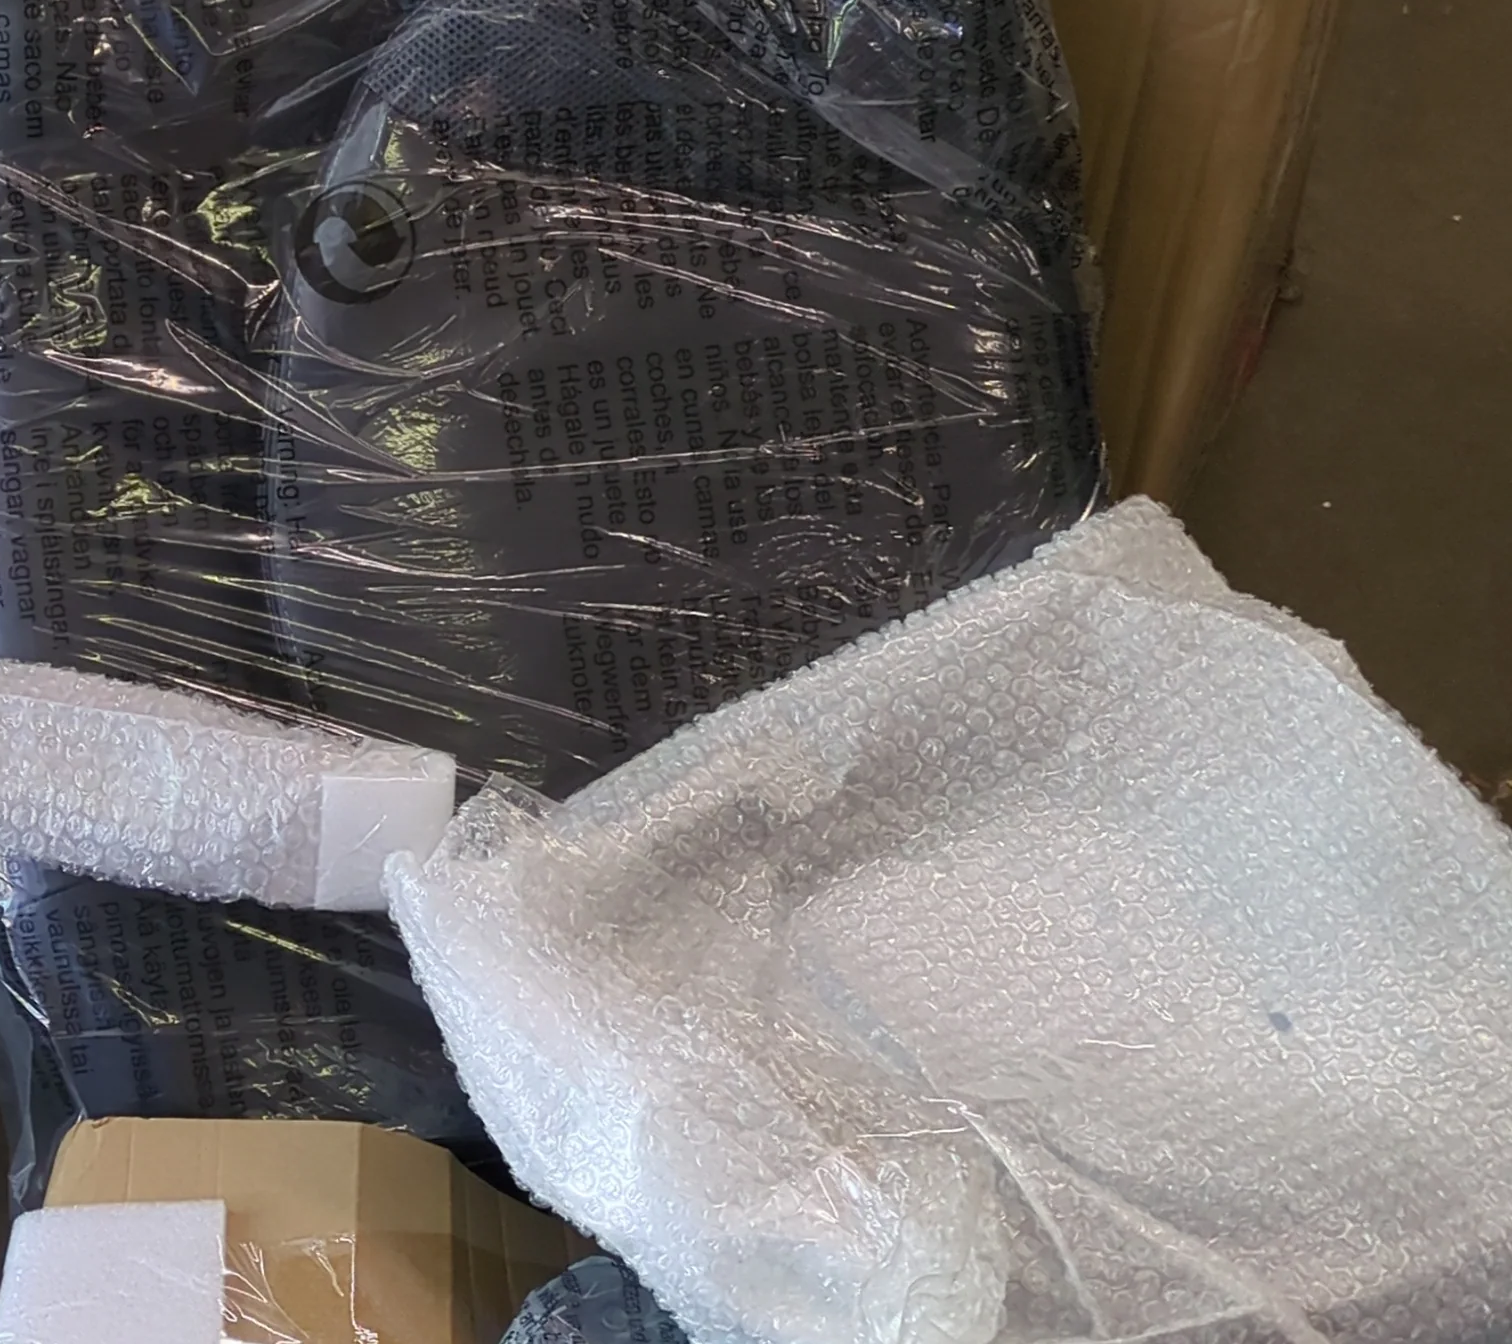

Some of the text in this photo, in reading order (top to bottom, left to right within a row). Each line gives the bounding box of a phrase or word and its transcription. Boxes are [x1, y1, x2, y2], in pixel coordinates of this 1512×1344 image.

[527, 368, 555, 439] antes
[734, 339, 764, 419] bebés
[791, 332, 821, 402] bolsa
[7, 535, 35, 625] vagnar
